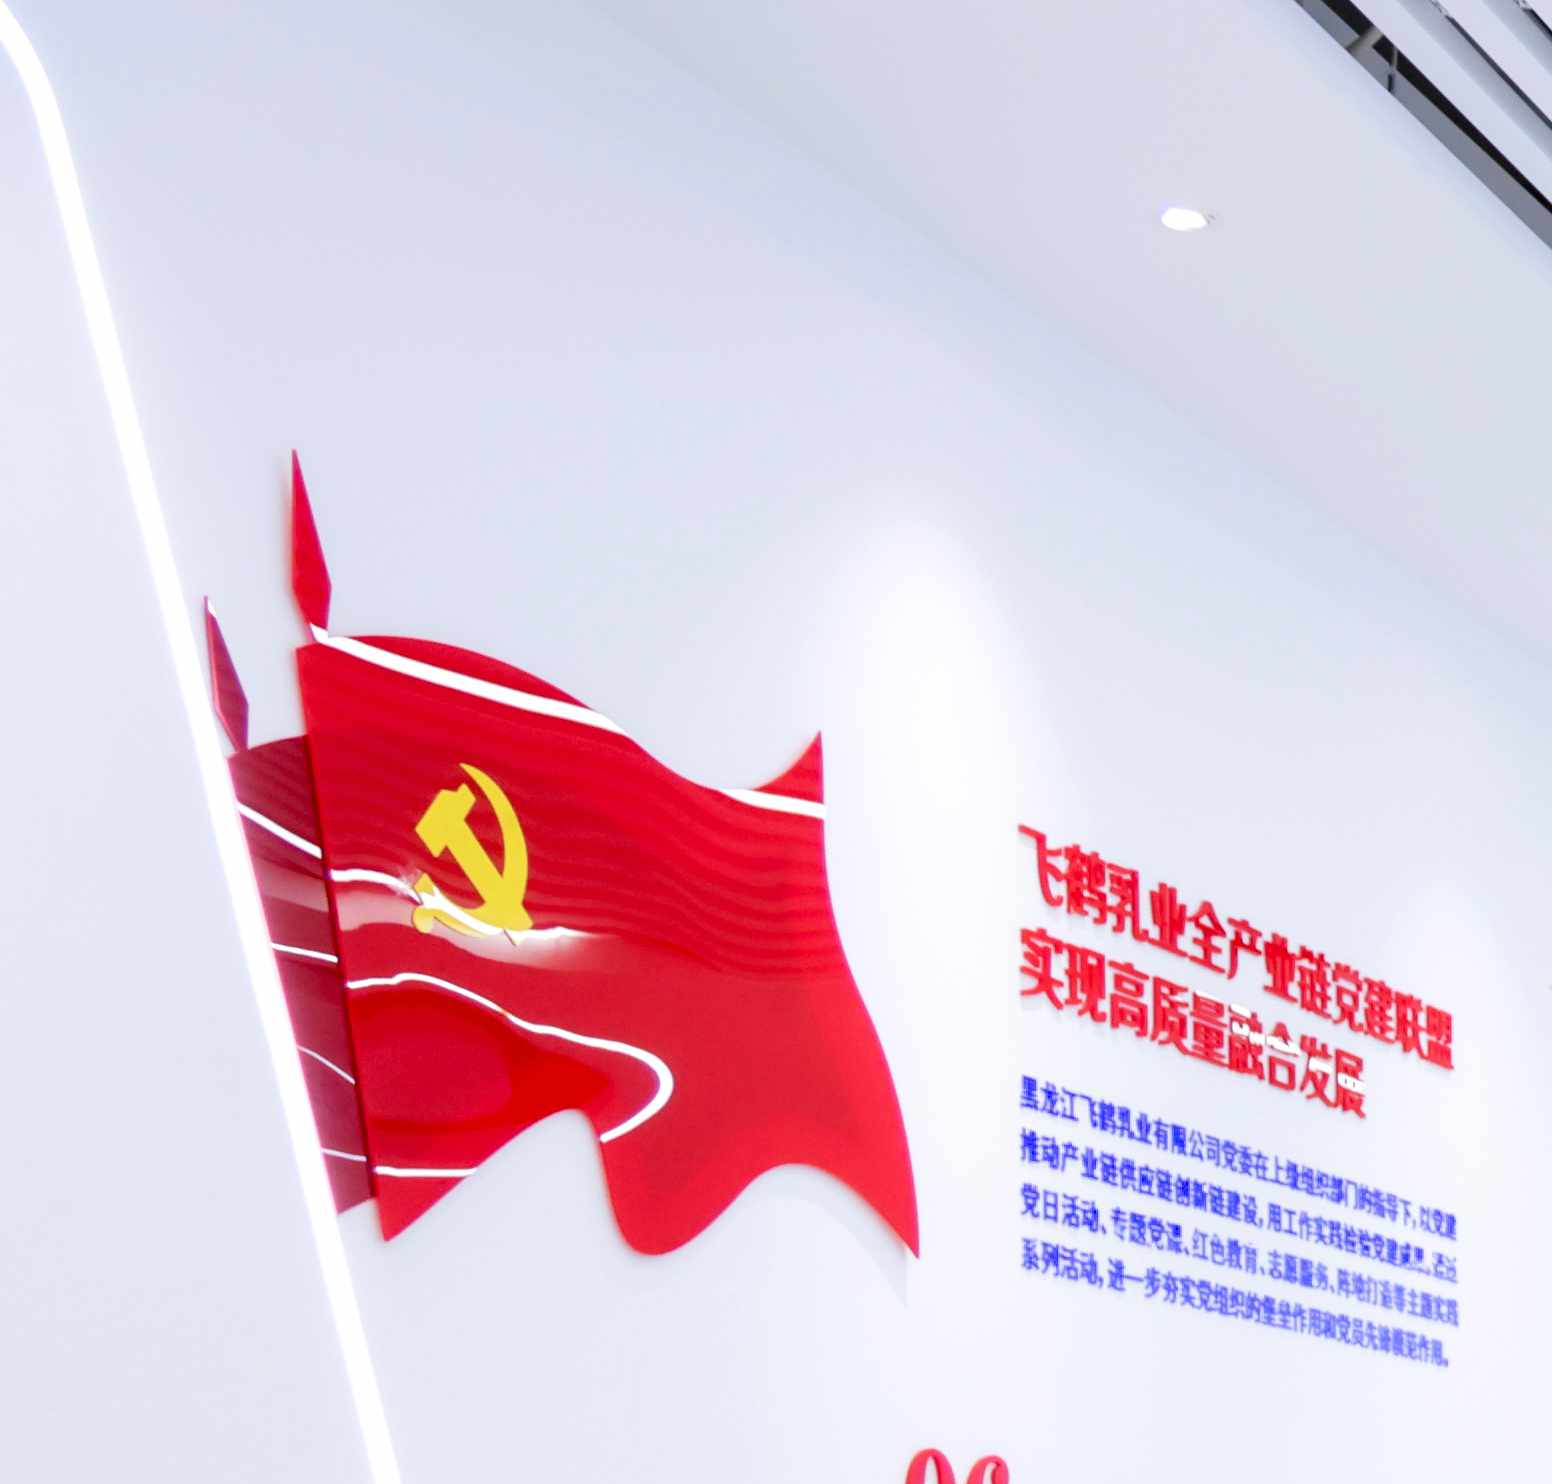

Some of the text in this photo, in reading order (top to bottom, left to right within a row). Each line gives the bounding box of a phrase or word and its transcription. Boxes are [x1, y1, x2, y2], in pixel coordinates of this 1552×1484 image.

[1018, 824, 1454, 1070] 飞鹤乳业全产业链党建联盟
[1019, 928, 1366, 1118] 实现高质量融合发展
